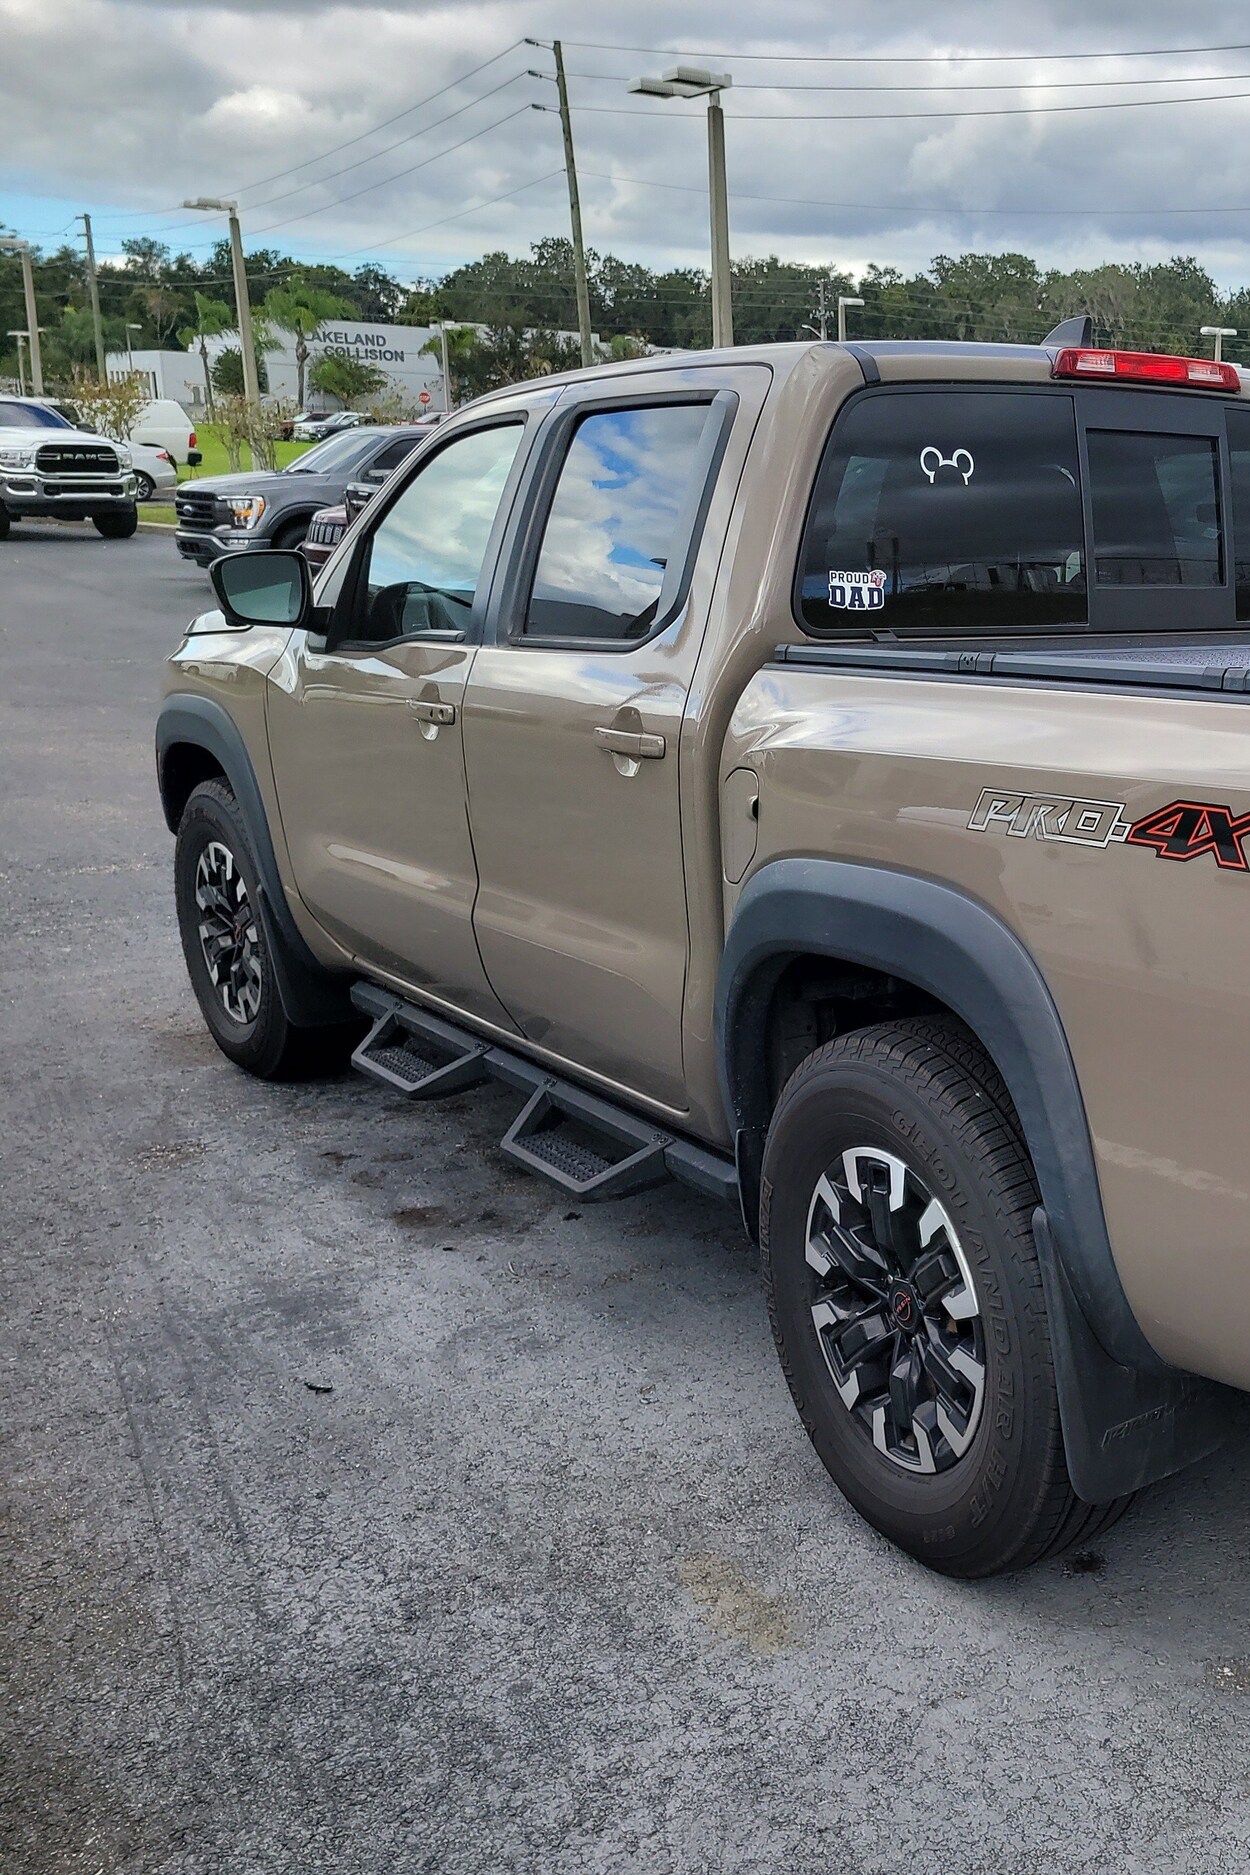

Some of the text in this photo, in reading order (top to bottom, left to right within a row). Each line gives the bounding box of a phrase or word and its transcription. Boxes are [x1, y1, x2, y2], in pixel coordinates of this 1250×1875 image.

[324, 345, 405, 362] COLLISION
[63, 452, 101, 461] RAM
[830, 572, 869, 584] PROUD
[829, 585, 883, 608] DAD
